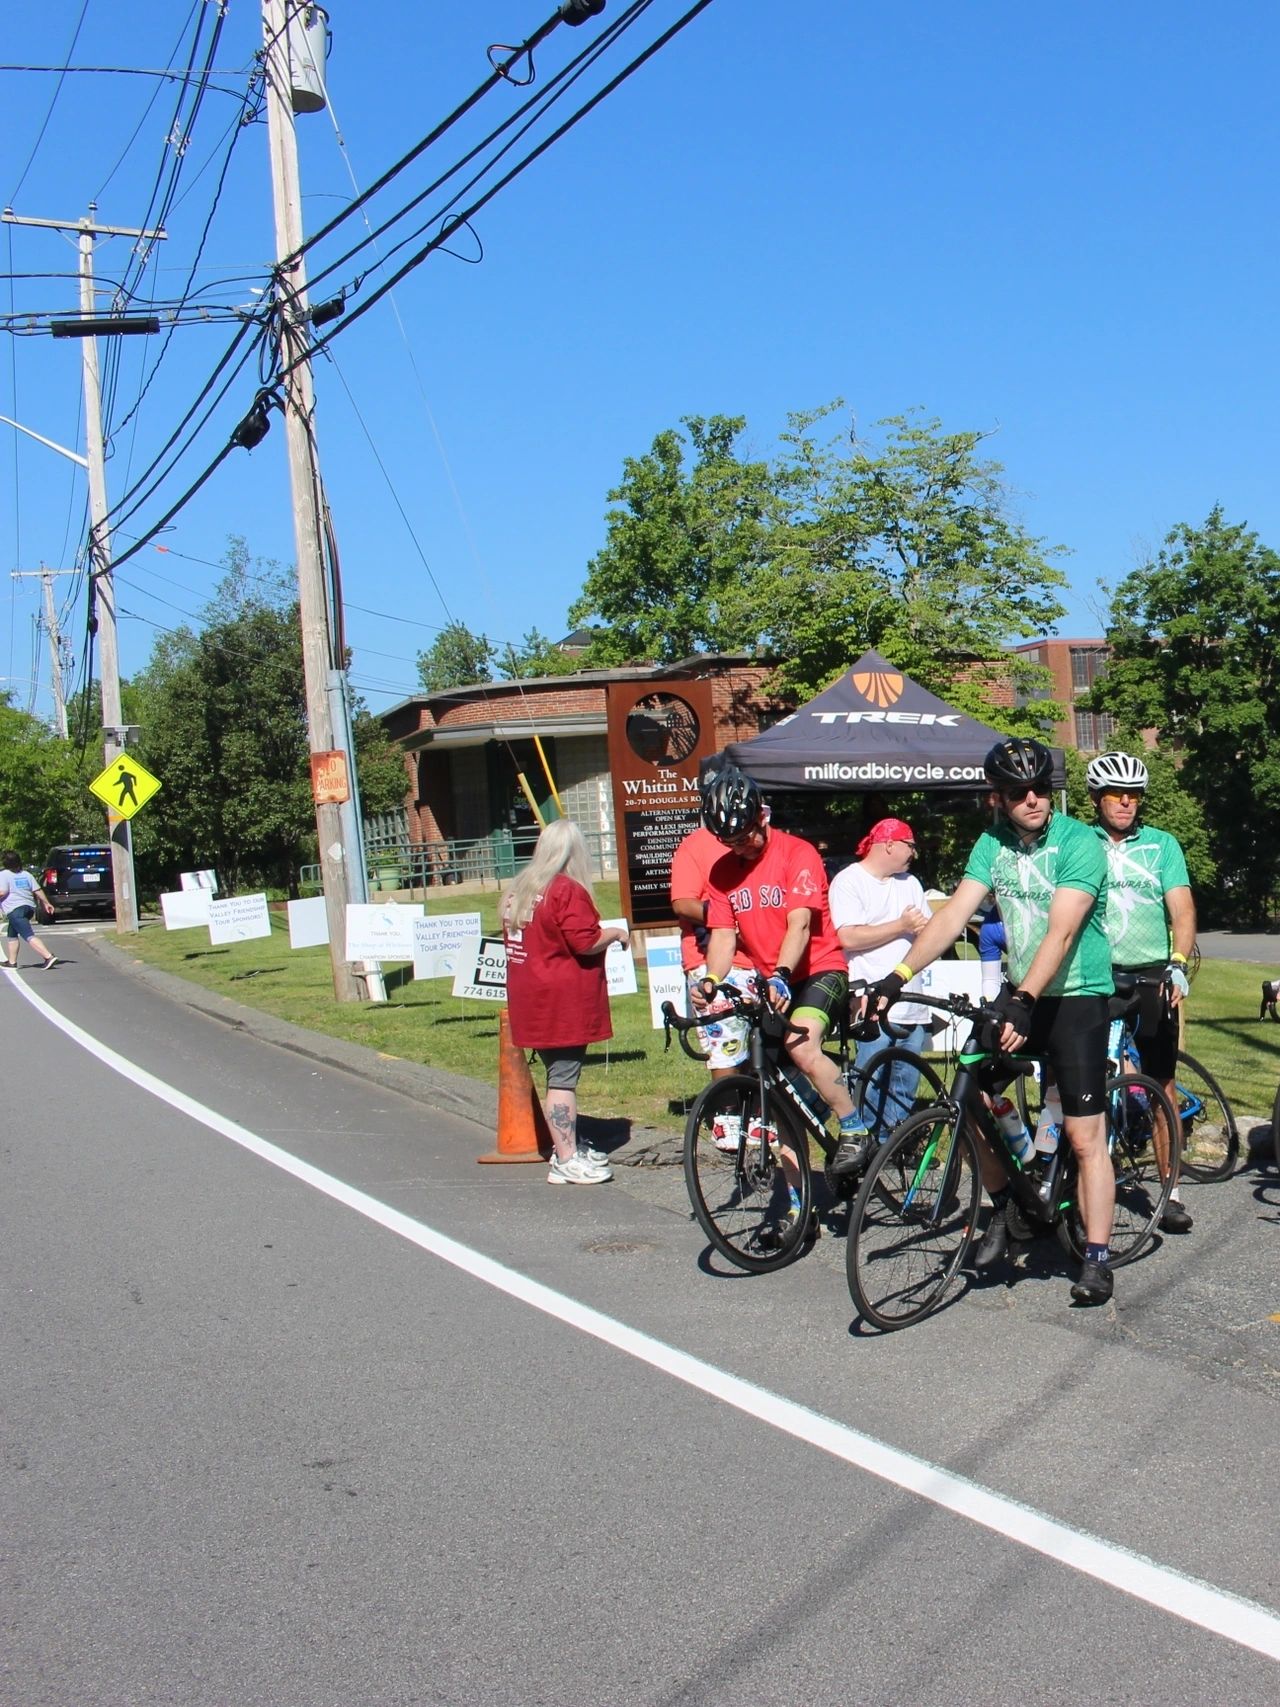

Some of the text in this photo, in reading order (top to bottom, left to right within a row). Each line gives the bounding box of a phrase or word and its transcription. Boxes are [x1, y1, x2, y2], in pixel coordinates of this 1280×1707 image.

[811, 711, 962, 727] TREK
[658, 769, 677, 779] The
[622, 779, 677, 794] Whitin
[649, 796, 688, 805] DOUGLAS
[641, 808, 690, 817] ALTERNATIVES
[633, 829, 682, 837] PERFORMANCE
[635, 852, 672, 860] SPAULDING
[642, 857, 673, 865] HERITAG
[634, 883, 658, 891] FAMILY
[208, 902, 228, 911] THANK
[209, 911, 232, 919] VALLEY
[416, 920, 438, 929] THANK
[439, 919, 453, 928] YOU
[416, 932, 440, 941] VALLEY
[420, 944, 438, 952] TOUR
[439, 942, 462, 951] SPONS
[485, 971, 505, 980] FEN
[463, 986, 505, 998] 774 615
[653, 984, 682, 994] Valley
